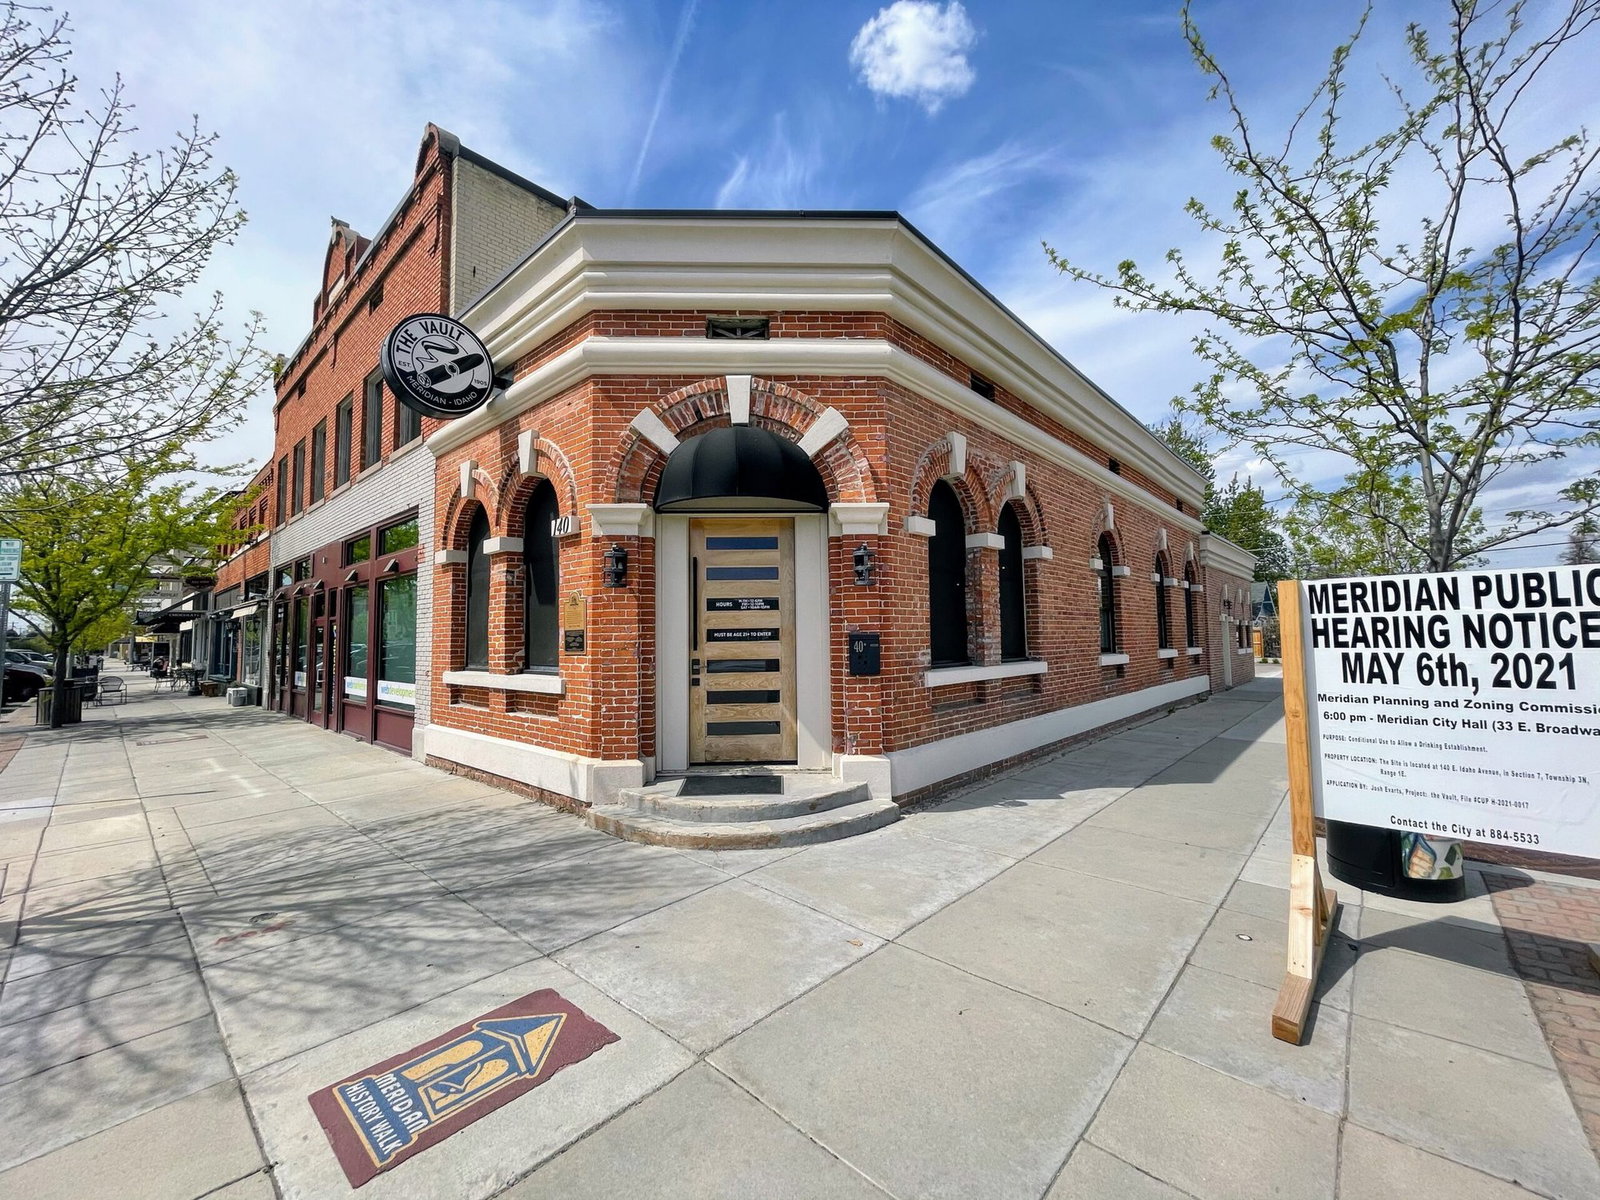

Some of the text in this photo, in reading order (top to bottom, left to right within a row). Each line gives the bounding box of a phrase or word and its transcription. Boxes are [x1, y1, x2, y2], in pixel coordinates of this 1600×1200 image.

[396, 321, 465, 354] THE VAULT
[407, 376, 447, 405] MERIDIAN
[454, 391, 477, 406] IDAHO
[552, 517, 569, 536] 140
[1308, 577, 1460, 614] MERIDIAN
[1311, 611, 1600, 649] HEARING NOTICE
[1342, 652, 1576, 696] MAY 6th, 2021
[1318, 694, 1600, 715] Meridian Planning and Zoning Commissi
[1323, 711, 1346, 721] 6:00
[1350, 715, 1366, 723] pm
[1377, 714, 1428, 726] Meridian
[1433, 717, 1457, 729] City
[1462, 719, 1488, 730] Hall
[1492, 720, 1513, 733] (33
[1518, 722, 1531, 732] E.
[1348, 736, 1377, 744] Conditional
[1419, 741, 1442, 750] Drinking
[1444, 743, 1488, 753] Establishment.
[1325, 753, 1349, 761] PROPERTY
[1351, 755, 1377, 763] LOCATION:
[1410, 761, 1430, 769] located
[1460, 765, 1476, 773] Idaho
[1478, 768, 1501, 777] Avenue,
[1511, 770, 1535, 779] Section
[1545, 773, 1576, 784] Township
[1380, 769, 1396, 777] Range
[1326, 779, 1358, 789] APPLICATION
[1430, 791, 1440, 799] the
[1460, 794, 1472, 802] File
[1390, 815, 1540, 845] Contact the City at 884-5533
[345, 1081, 403, 1155] HISTORY WALK
[374, 1073, 429, 1134] MERIDIAN
